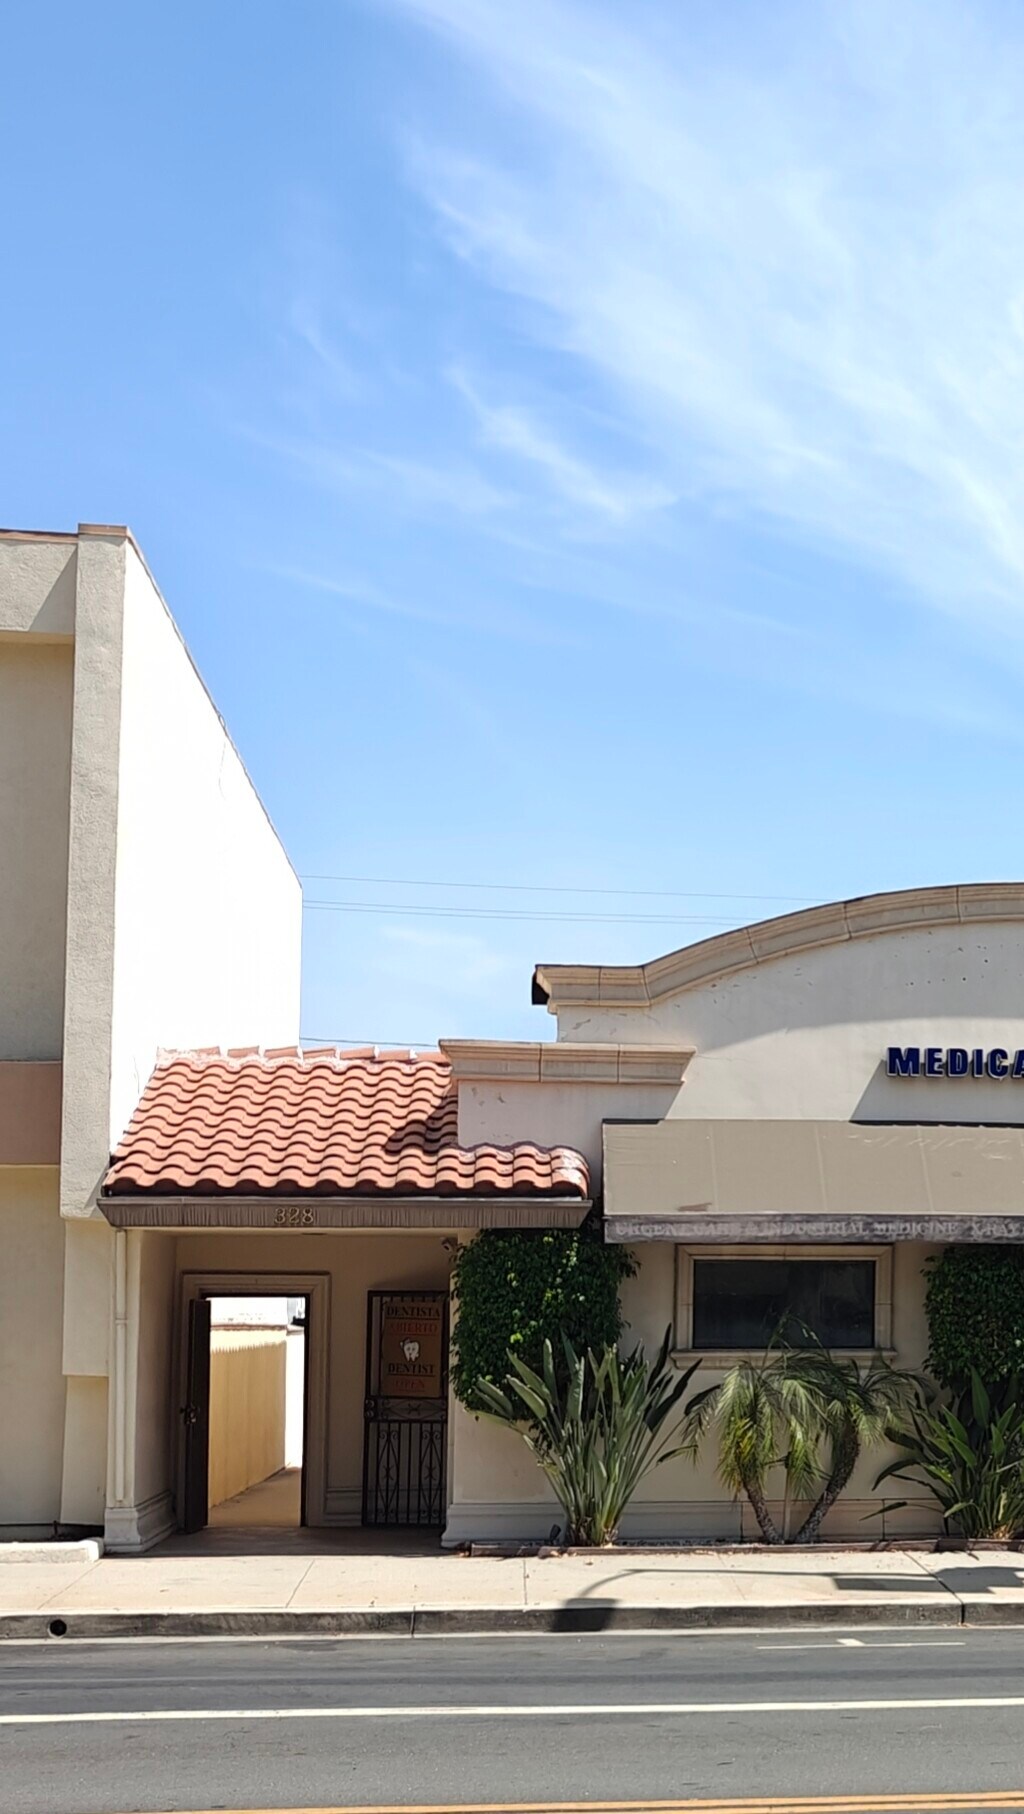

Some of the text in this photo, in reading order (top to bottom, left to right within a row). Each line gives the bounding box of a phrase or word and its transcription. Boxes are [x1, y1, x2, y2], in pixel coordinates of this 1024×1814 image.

[274, 1207, 314, 1224] 328
[873, 1221, 957, 1236] MEDICINE
[386, 1305, 441, 1317] DENTISTA
[387, 1363, 435, 1374] DENTIST
